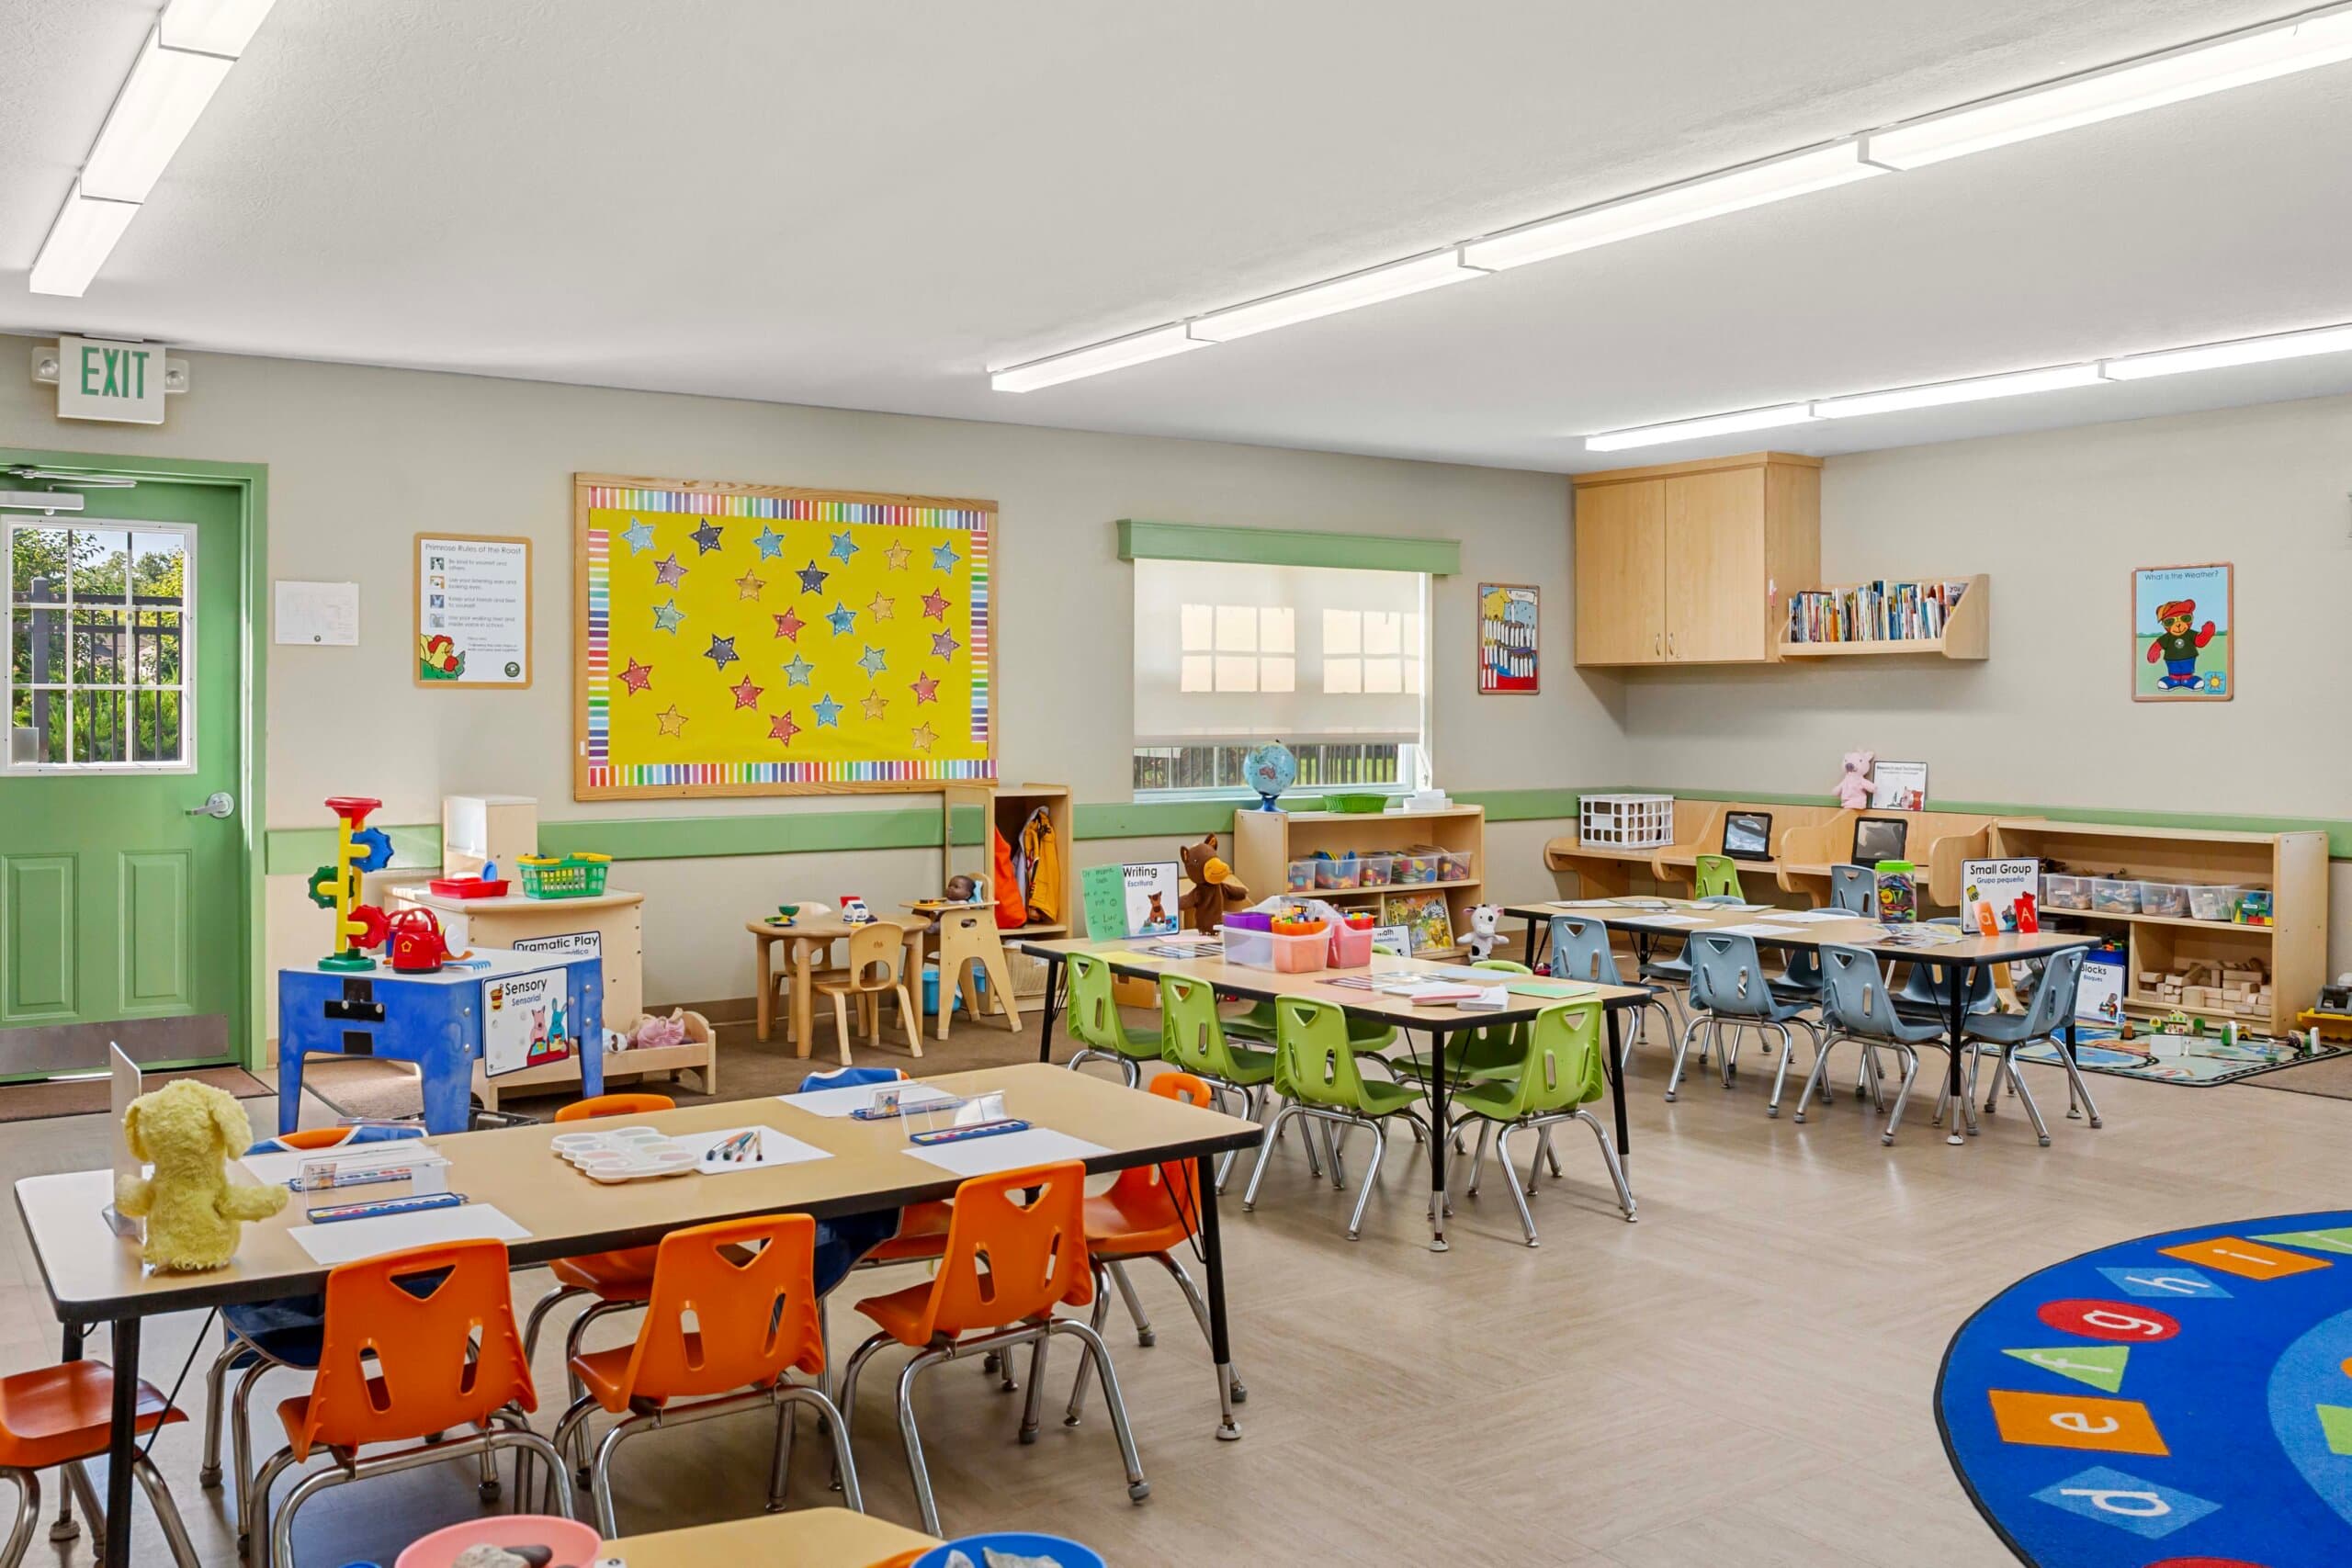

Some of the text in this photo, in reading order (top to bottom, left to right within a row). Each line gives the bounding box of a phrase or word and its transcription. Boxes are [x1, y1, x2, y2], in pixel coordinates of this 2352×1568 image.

[81, 345, 150, 399] EXIT
[425, 544, 456, 552] Primrose
[2185, 570, 2219, 579] Weather?
[1123, 866, 1158, 878] Writing
[1970, 863, 2031, 875] Small Group
[1996, 875, 2025, 885] pequeño
[1979, 912, 1992, 926] a
[2021, 907, 2033, 922] A
[516, 938, 571, 952] Dramatic
[574, 935, 598, 946] Play
[505, 978, 548, 996] Sensory
[511, 993, 542, 1007] Sensorial
[2124, 1275, 2211, 1294] h
[2082, 1310, 2163, 1336] g
[2030, 1353, 2114, 1373] f
[2049, 1412, 2120, 1434] e
[2059, 1488, 2171, 1517] d
